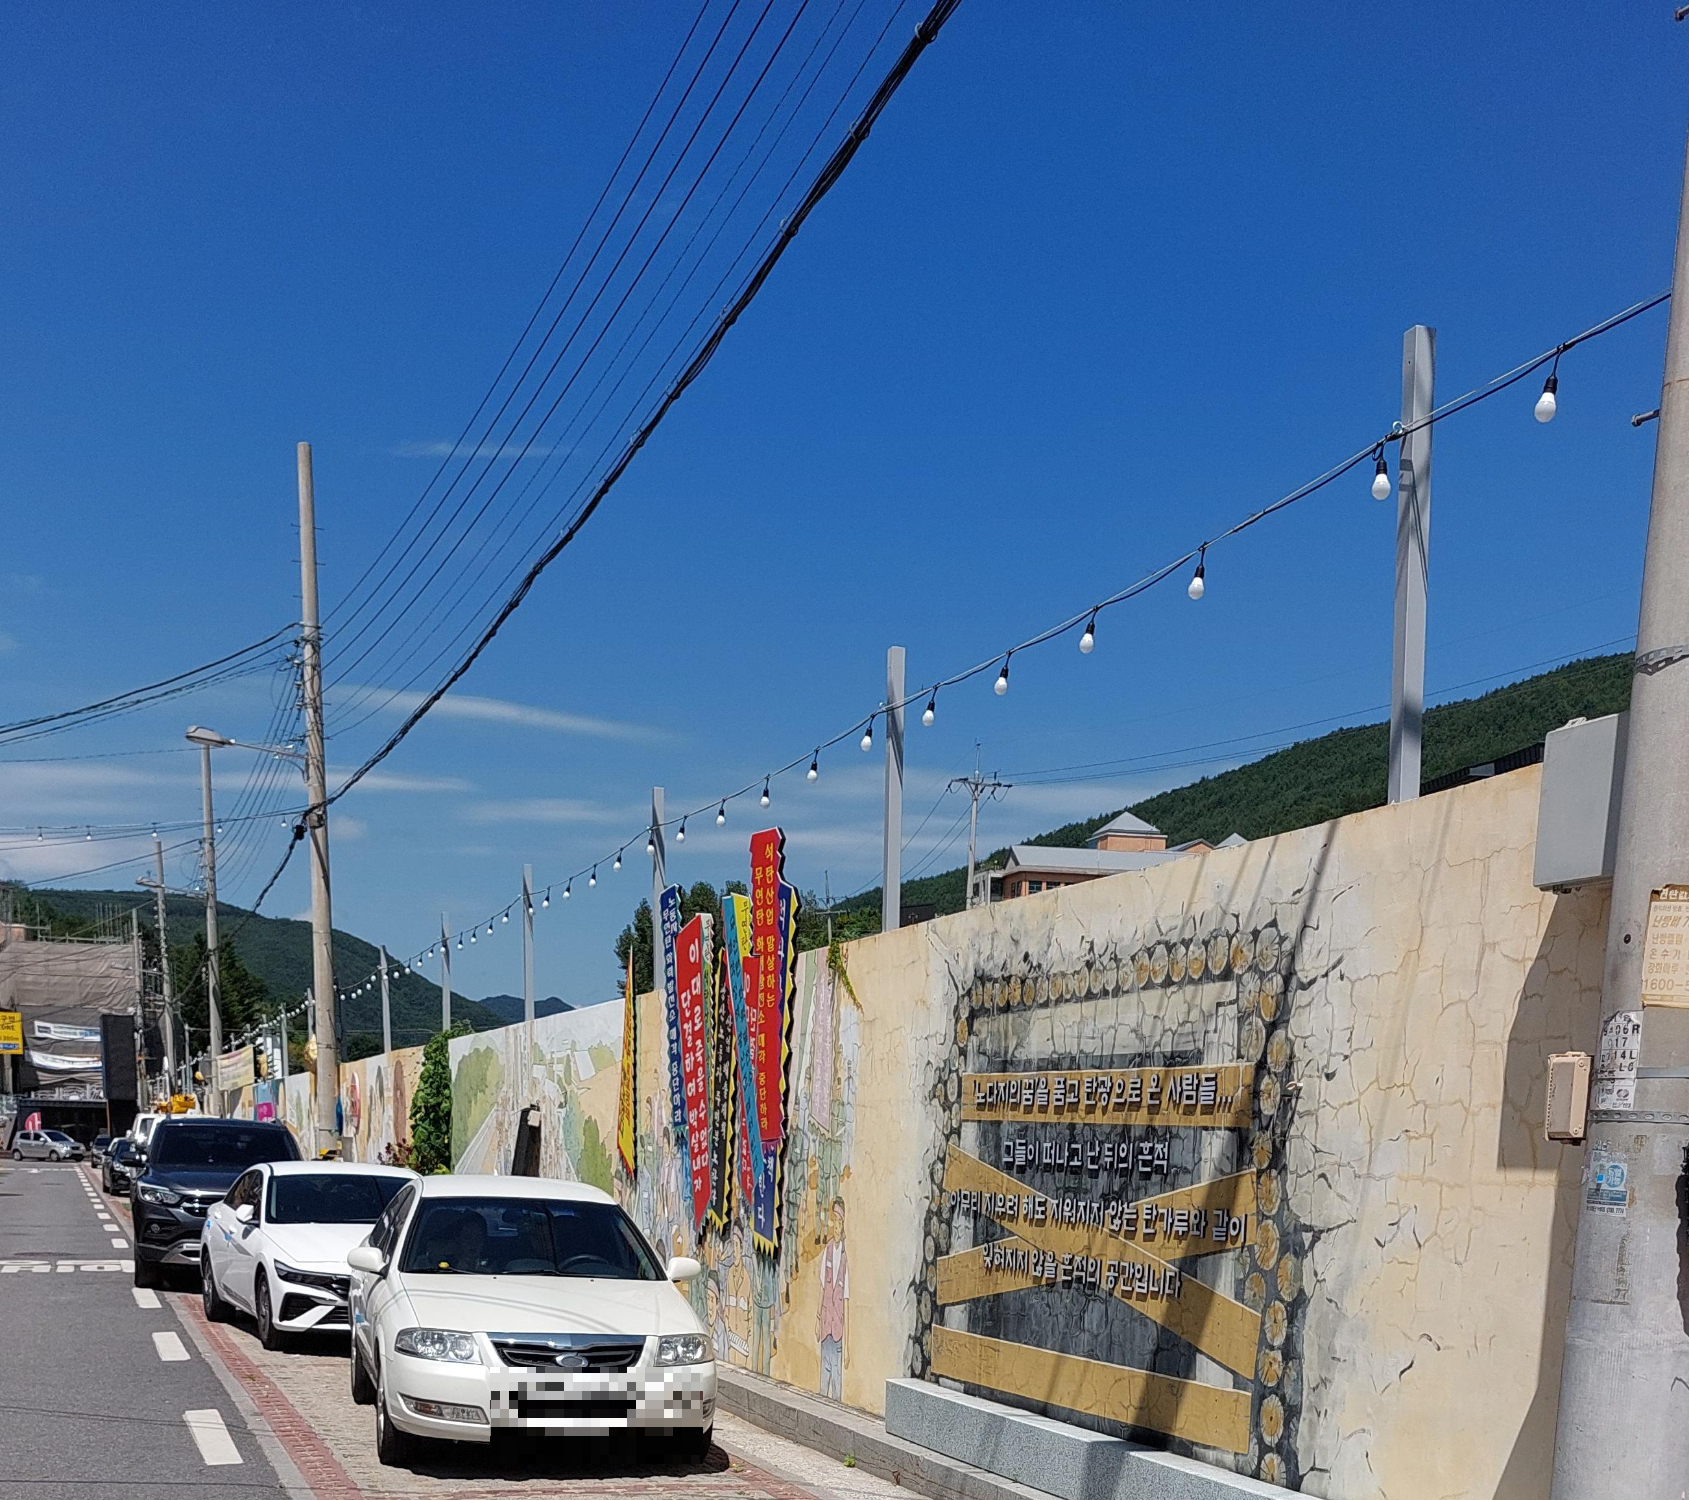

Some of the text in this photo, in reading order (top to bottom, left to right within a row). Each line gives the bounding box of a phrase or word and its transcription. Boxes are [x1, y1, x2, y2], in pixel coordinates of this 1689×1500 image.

[1053, 1077, 1079, 1106] 품고
[1084, 1076, 1142, 1106] 탄광으로
[1147, 1074, 1161, 1105] 온
[1003, 1140, 1169, 1174] 그들이 떠나고 난 뒤의 흔적
[951, 1190, 1247, 1243] 아무리 지우려 해도 지워지지 않는 탄가루와 같이
[983, 1243, 1182, 1299] 잊혀지지 않을 흔적의 공간입니다
